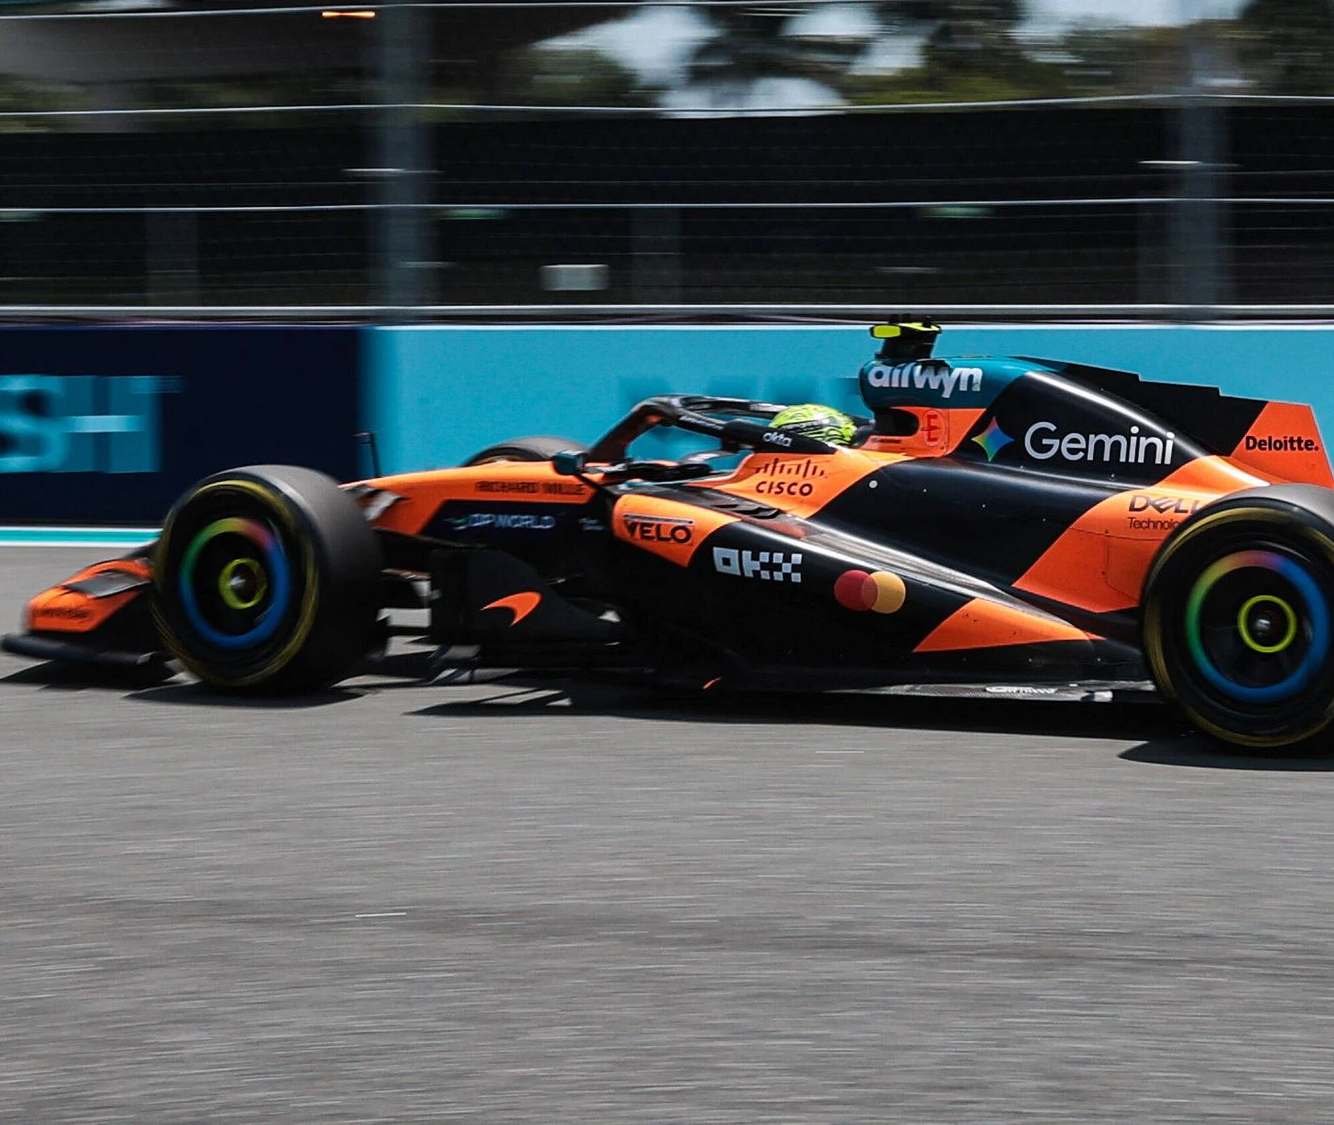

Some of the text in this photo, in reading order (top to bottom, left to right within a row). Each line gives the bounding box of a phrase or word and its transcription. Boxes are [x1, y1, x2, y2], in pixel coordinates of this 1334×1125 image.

[762, 432, 793, 447] okta
[1024, 421, 1176, 465] Gemini
[1245, 435, 1320, 452] Deloitte.
[755, 480, 814, 497] CISCO
[624, 520, 693, 544] VELO
[1127, 517, 1181, 531] Technolo
[713, 546, 803, 583] OKX
